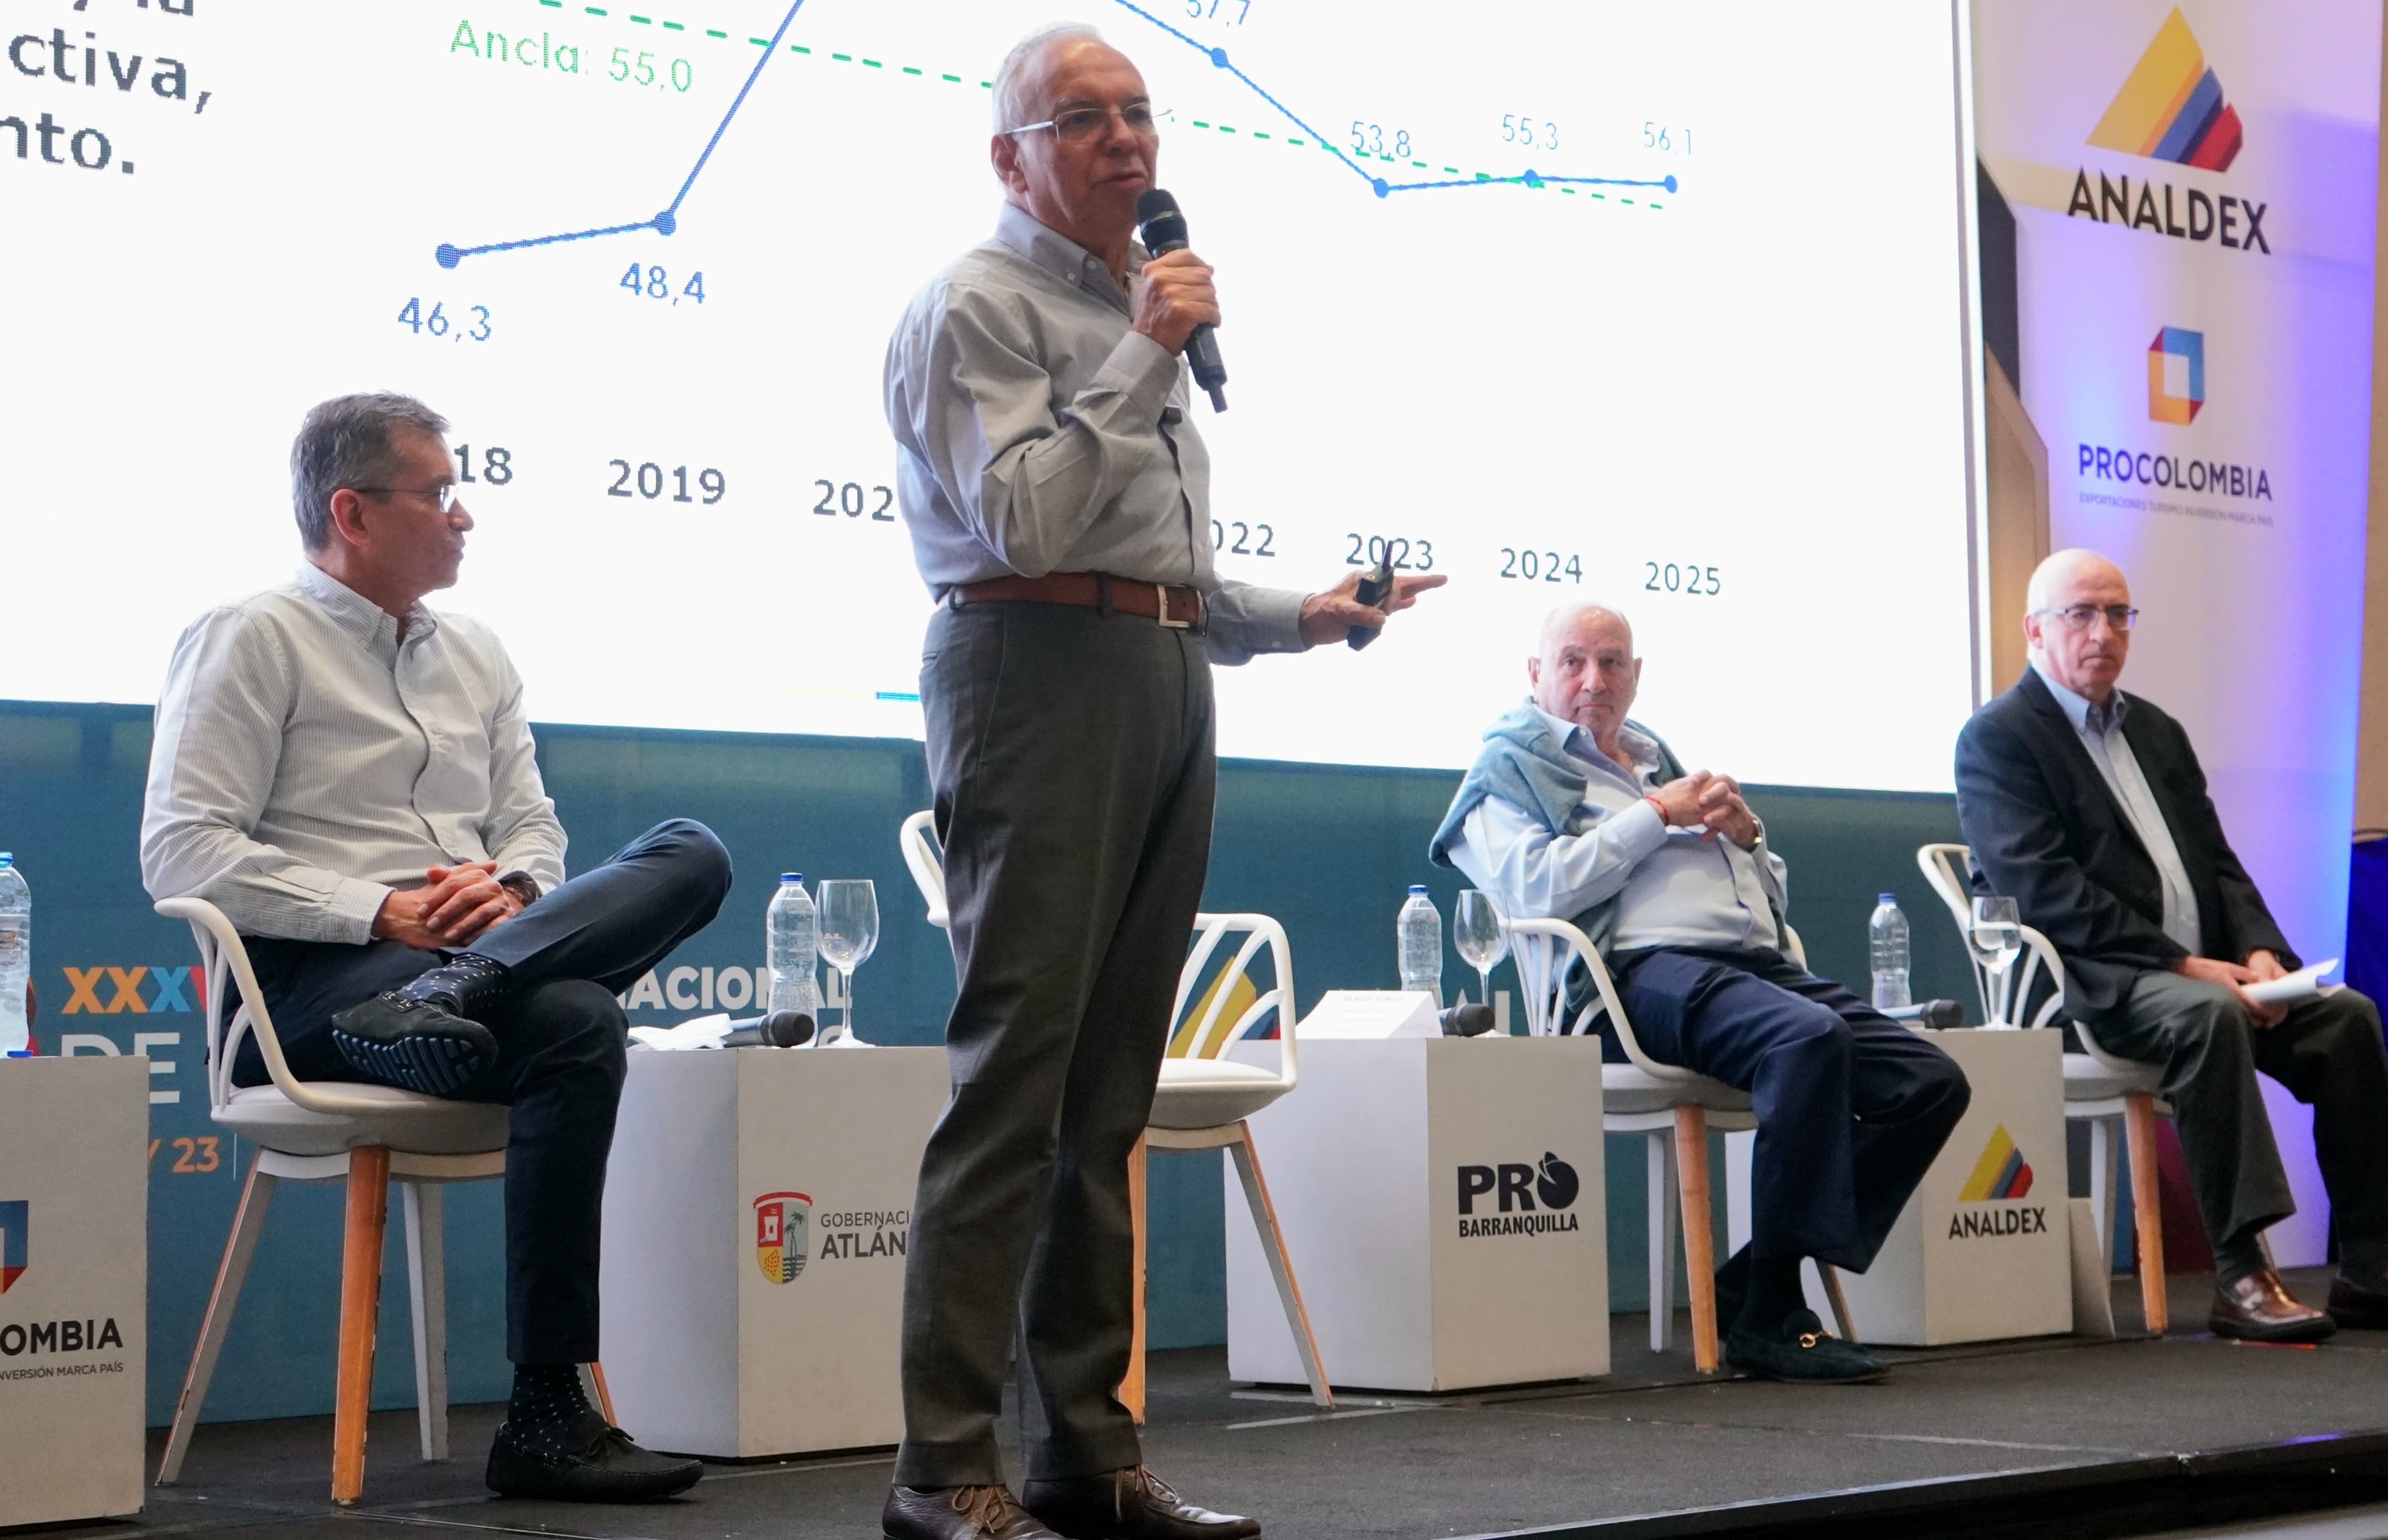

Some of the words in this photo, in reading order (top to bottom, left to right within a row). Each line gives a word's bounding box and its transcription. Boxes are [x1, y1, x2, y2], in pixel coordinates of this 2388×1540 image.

[8, 28, 212, 114] ctiva,
[450, 20, 588, 75] Ancla:
[609, 47, 692, 92] 55,0
[1351, 121, 1410, 159] 53,8
[1502, 114, 1558, 150] 55,3
[1644, 122, 1691, 155] 56,1
[2068, 166, 2271, 254] ANALDEX
[620, 262, 705, 306] 48,4
[398, 297, 491, 342] 46,3
[608, 459, 725, 505] 2019
[2079, 444, 2272, 501] PROCOLOMBIA
[1346, 533, 1434, 571] 2023
[1501, 548, 1583, 584] 2024
[1645, 561, 1720, 596] 2025
[173, 1136, 219, 1173] 23
[821, 1210, 909, 1228] GOBERNACI
[1459, 1213, 1579, 1238] BARRANQUILLA
[1949, 1207, 2047, 1240] ANALDEX
[820, 1224, 906, 1259] ATLÁN
[0, 1318, 123, 1356] OMBIA
[57, 1364, 97, 1376] MARCA
[100, 1361, 123, 1374] PAÍS
